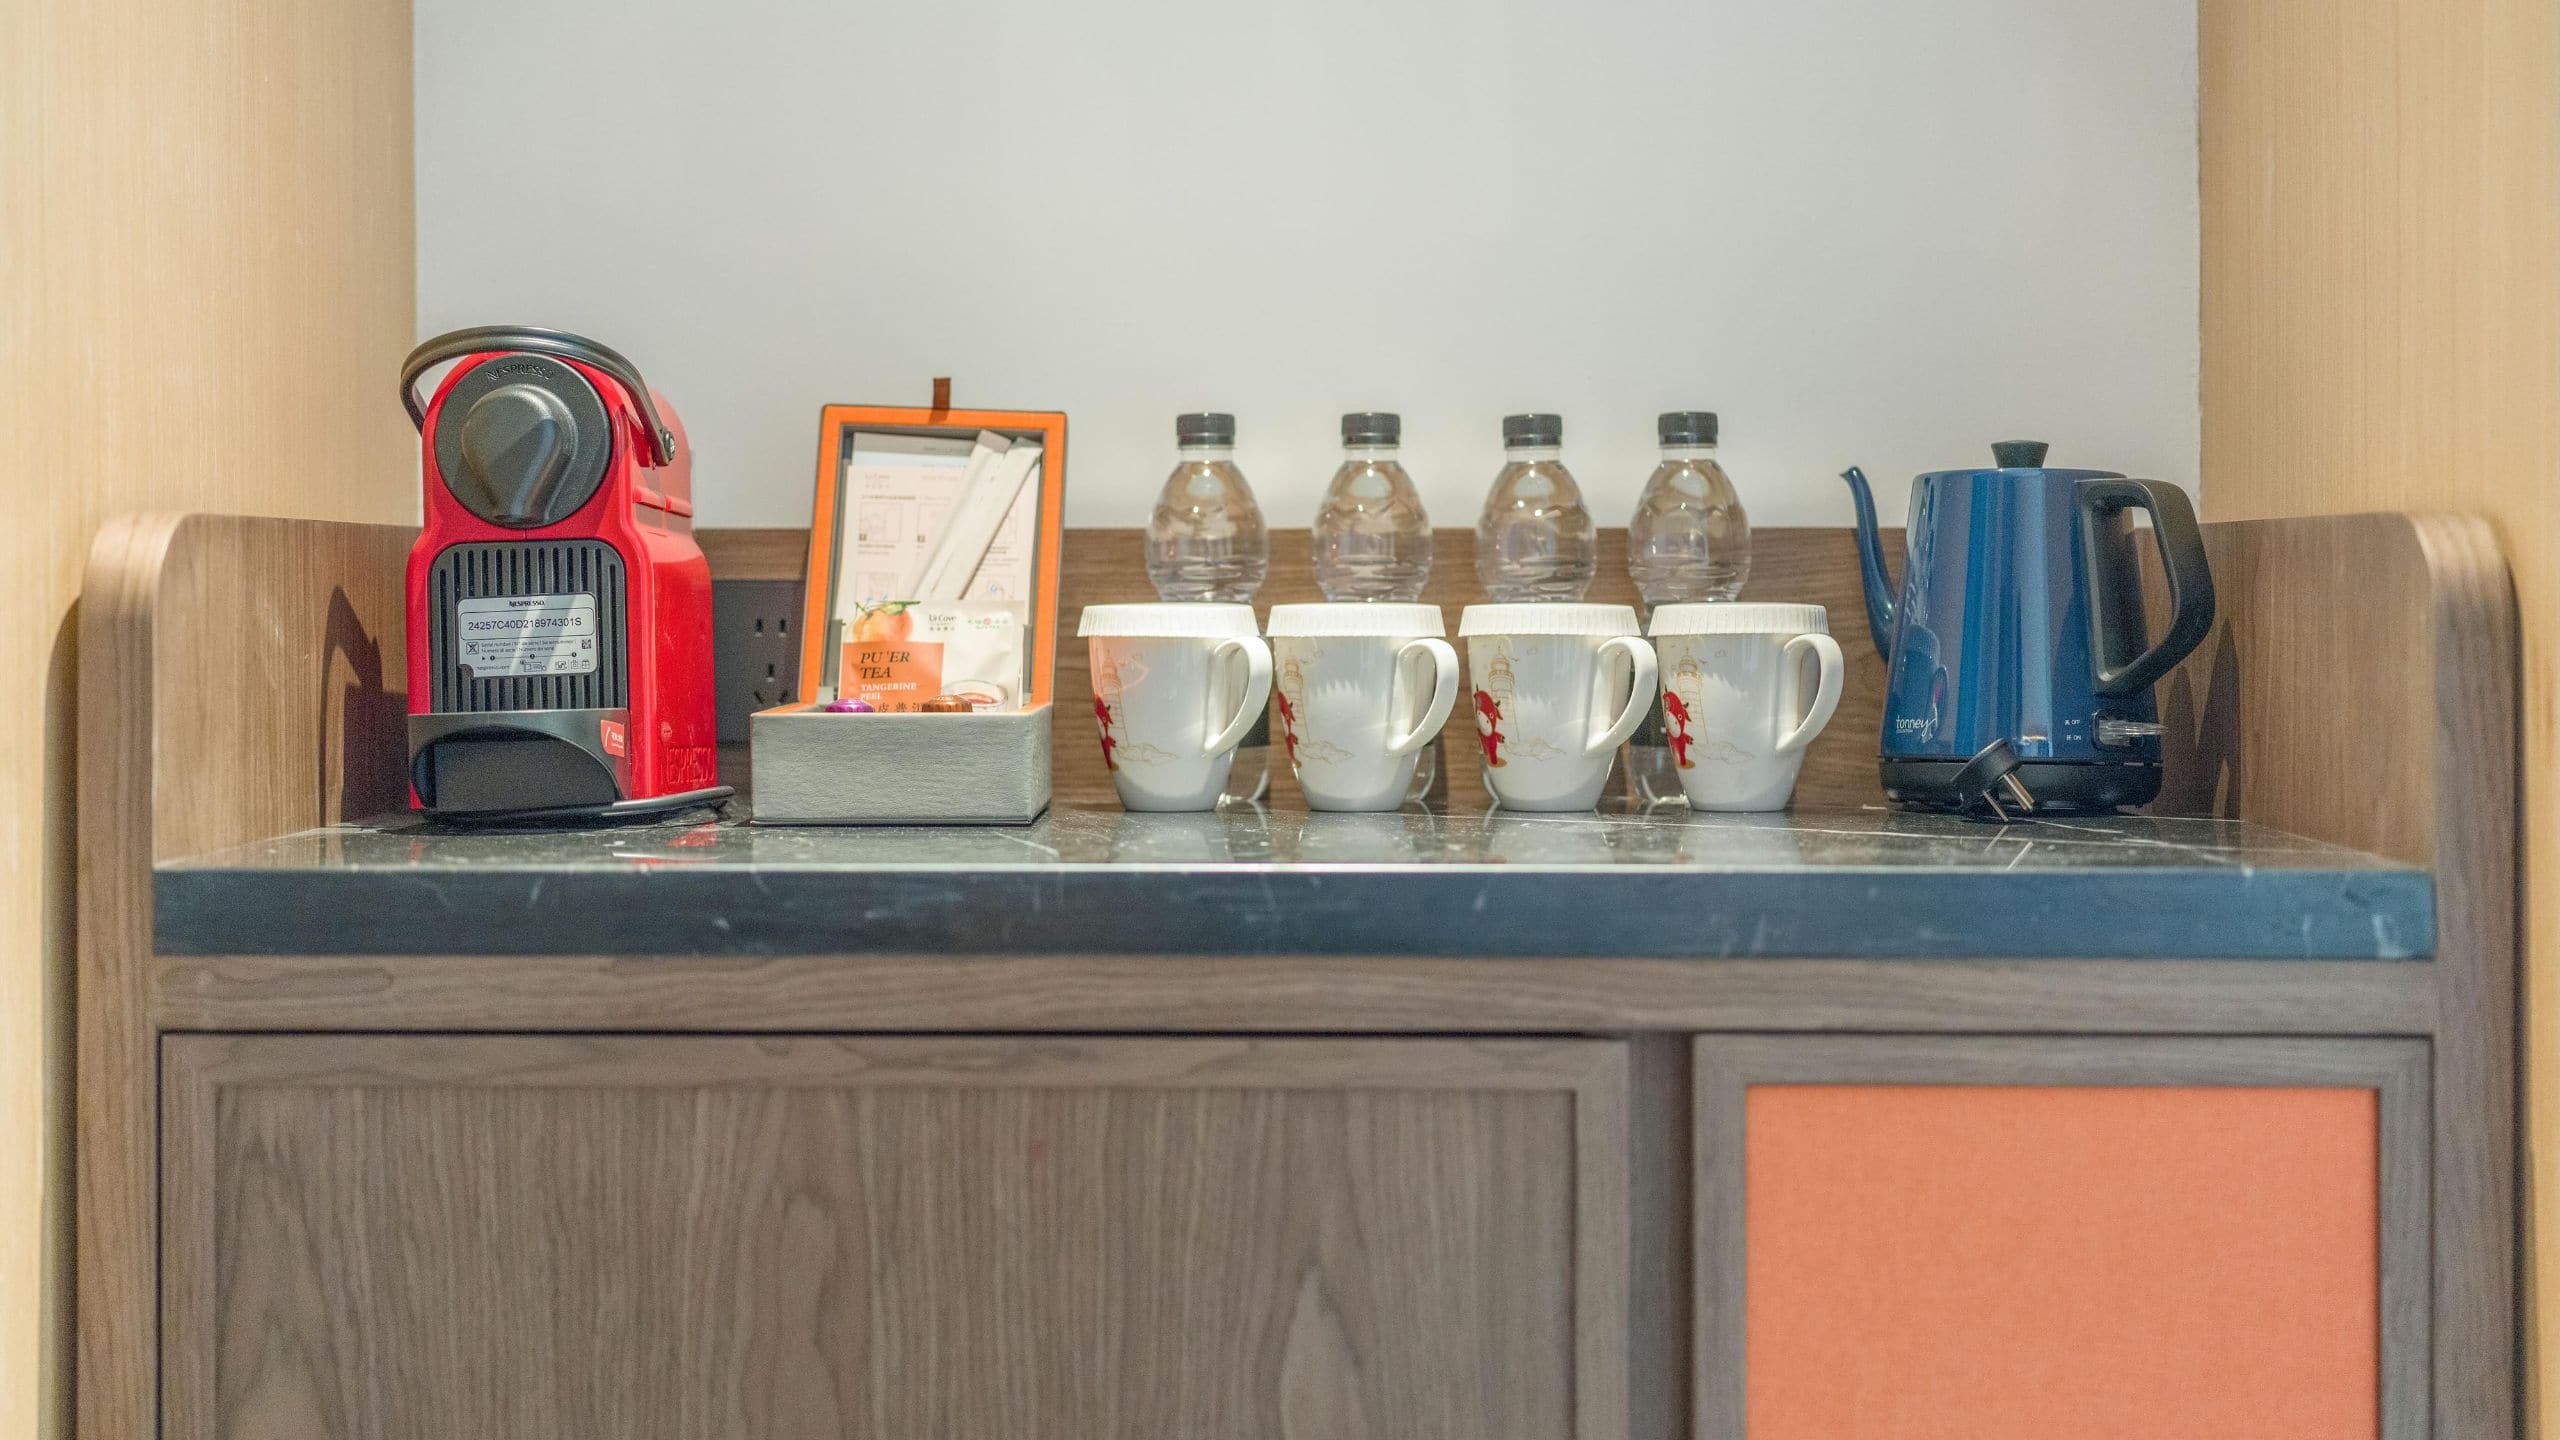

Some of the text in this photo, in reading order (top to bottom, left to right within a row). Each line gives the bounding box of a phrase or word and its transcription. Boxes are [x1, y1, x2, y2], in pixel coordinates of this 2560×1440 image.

[468, 617, 582, 631] 24257C40D218974301S
[860, 666, 892, 679] TEA
[861, 681, 918, 692] TANGERINE
[1895, 714, 1931, 737] tonney
